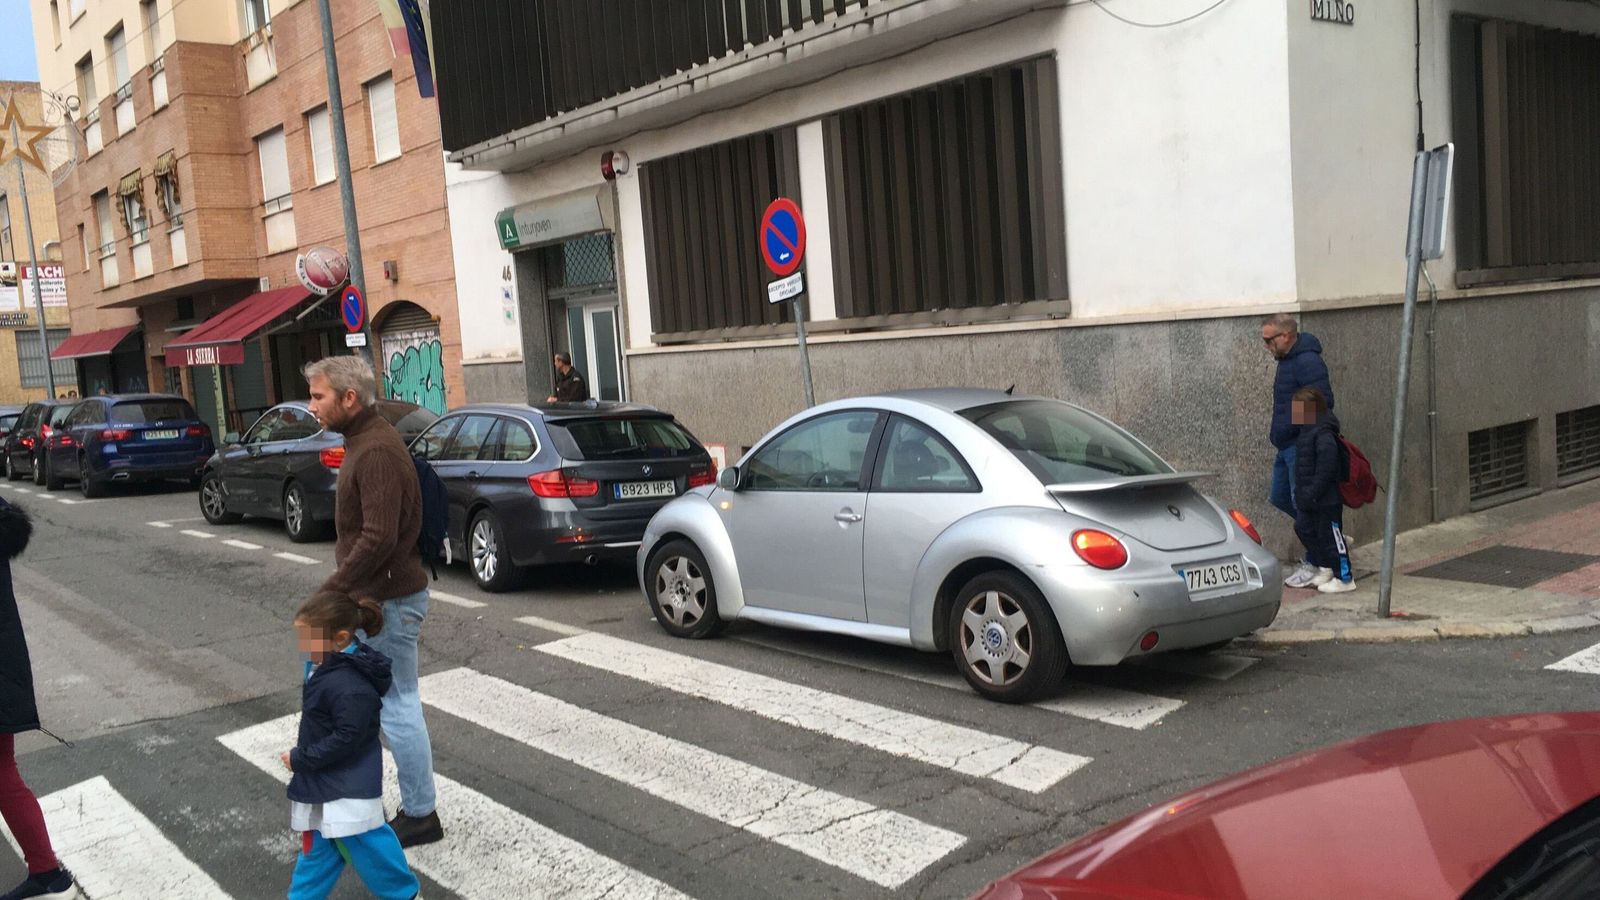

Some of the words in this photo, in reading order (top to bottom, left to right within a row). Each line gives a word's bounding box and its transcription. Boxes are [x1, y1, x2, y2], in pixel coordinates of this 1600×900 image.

[502, 265, 512, 281] 46
[186, 349, 194, 366] LA
[621, 482, 650, 496] 6923
[653, 481, 674, 495] HPS
[1187, 568, 1217, 590] 7743
[1220, 564, 1241, 583] CCS
